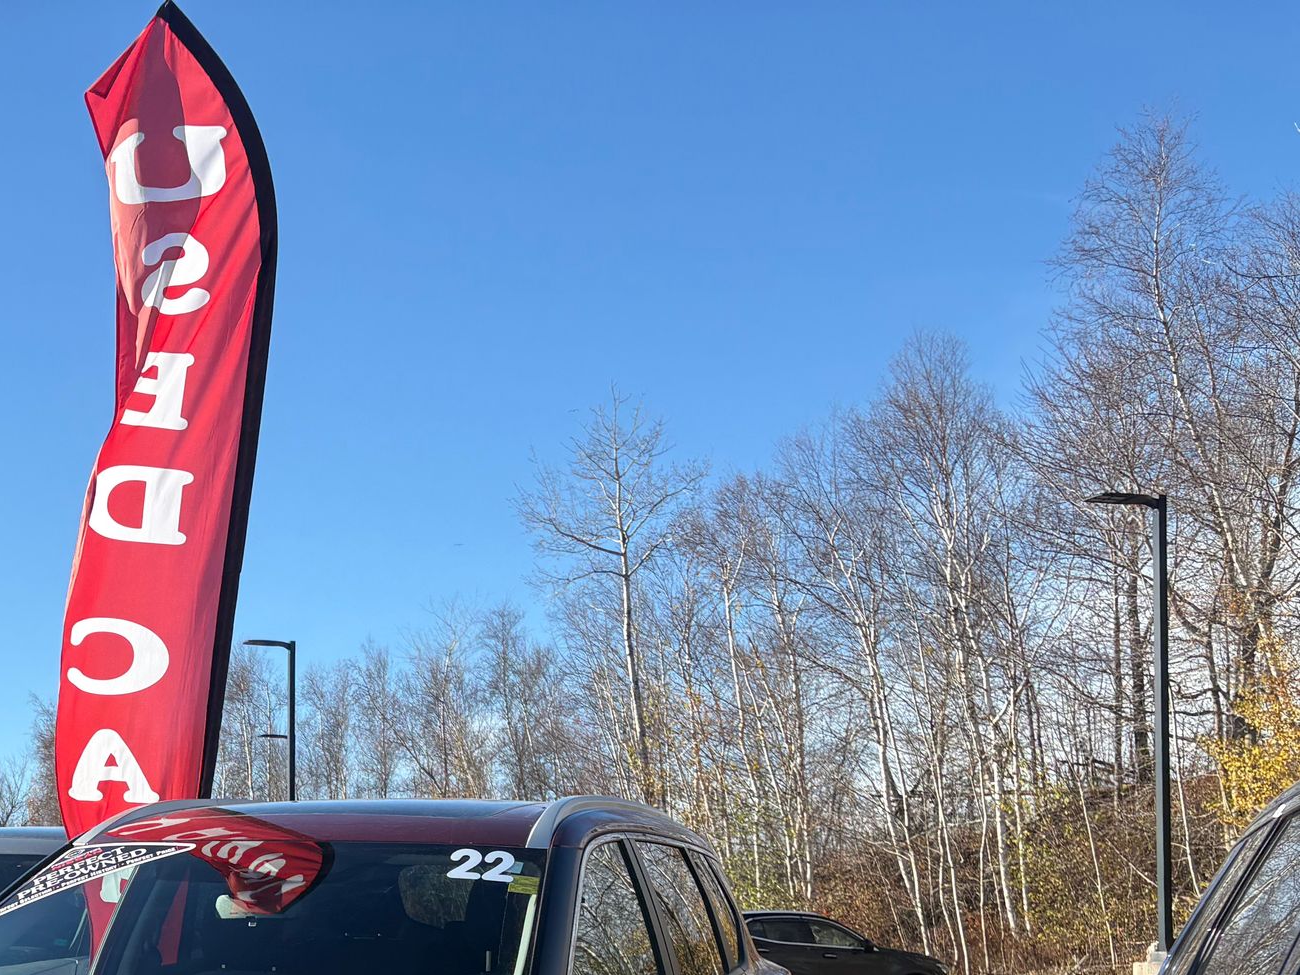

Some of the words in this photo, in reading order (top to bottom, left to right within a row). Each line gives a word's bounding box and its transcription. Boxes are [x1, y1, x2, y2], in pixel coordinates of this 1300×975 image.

[17, 848, 147, 899] PRE-OWNED
[33, 846, 126, 886] PERFECT
[446, 848, 515, 883] 22
